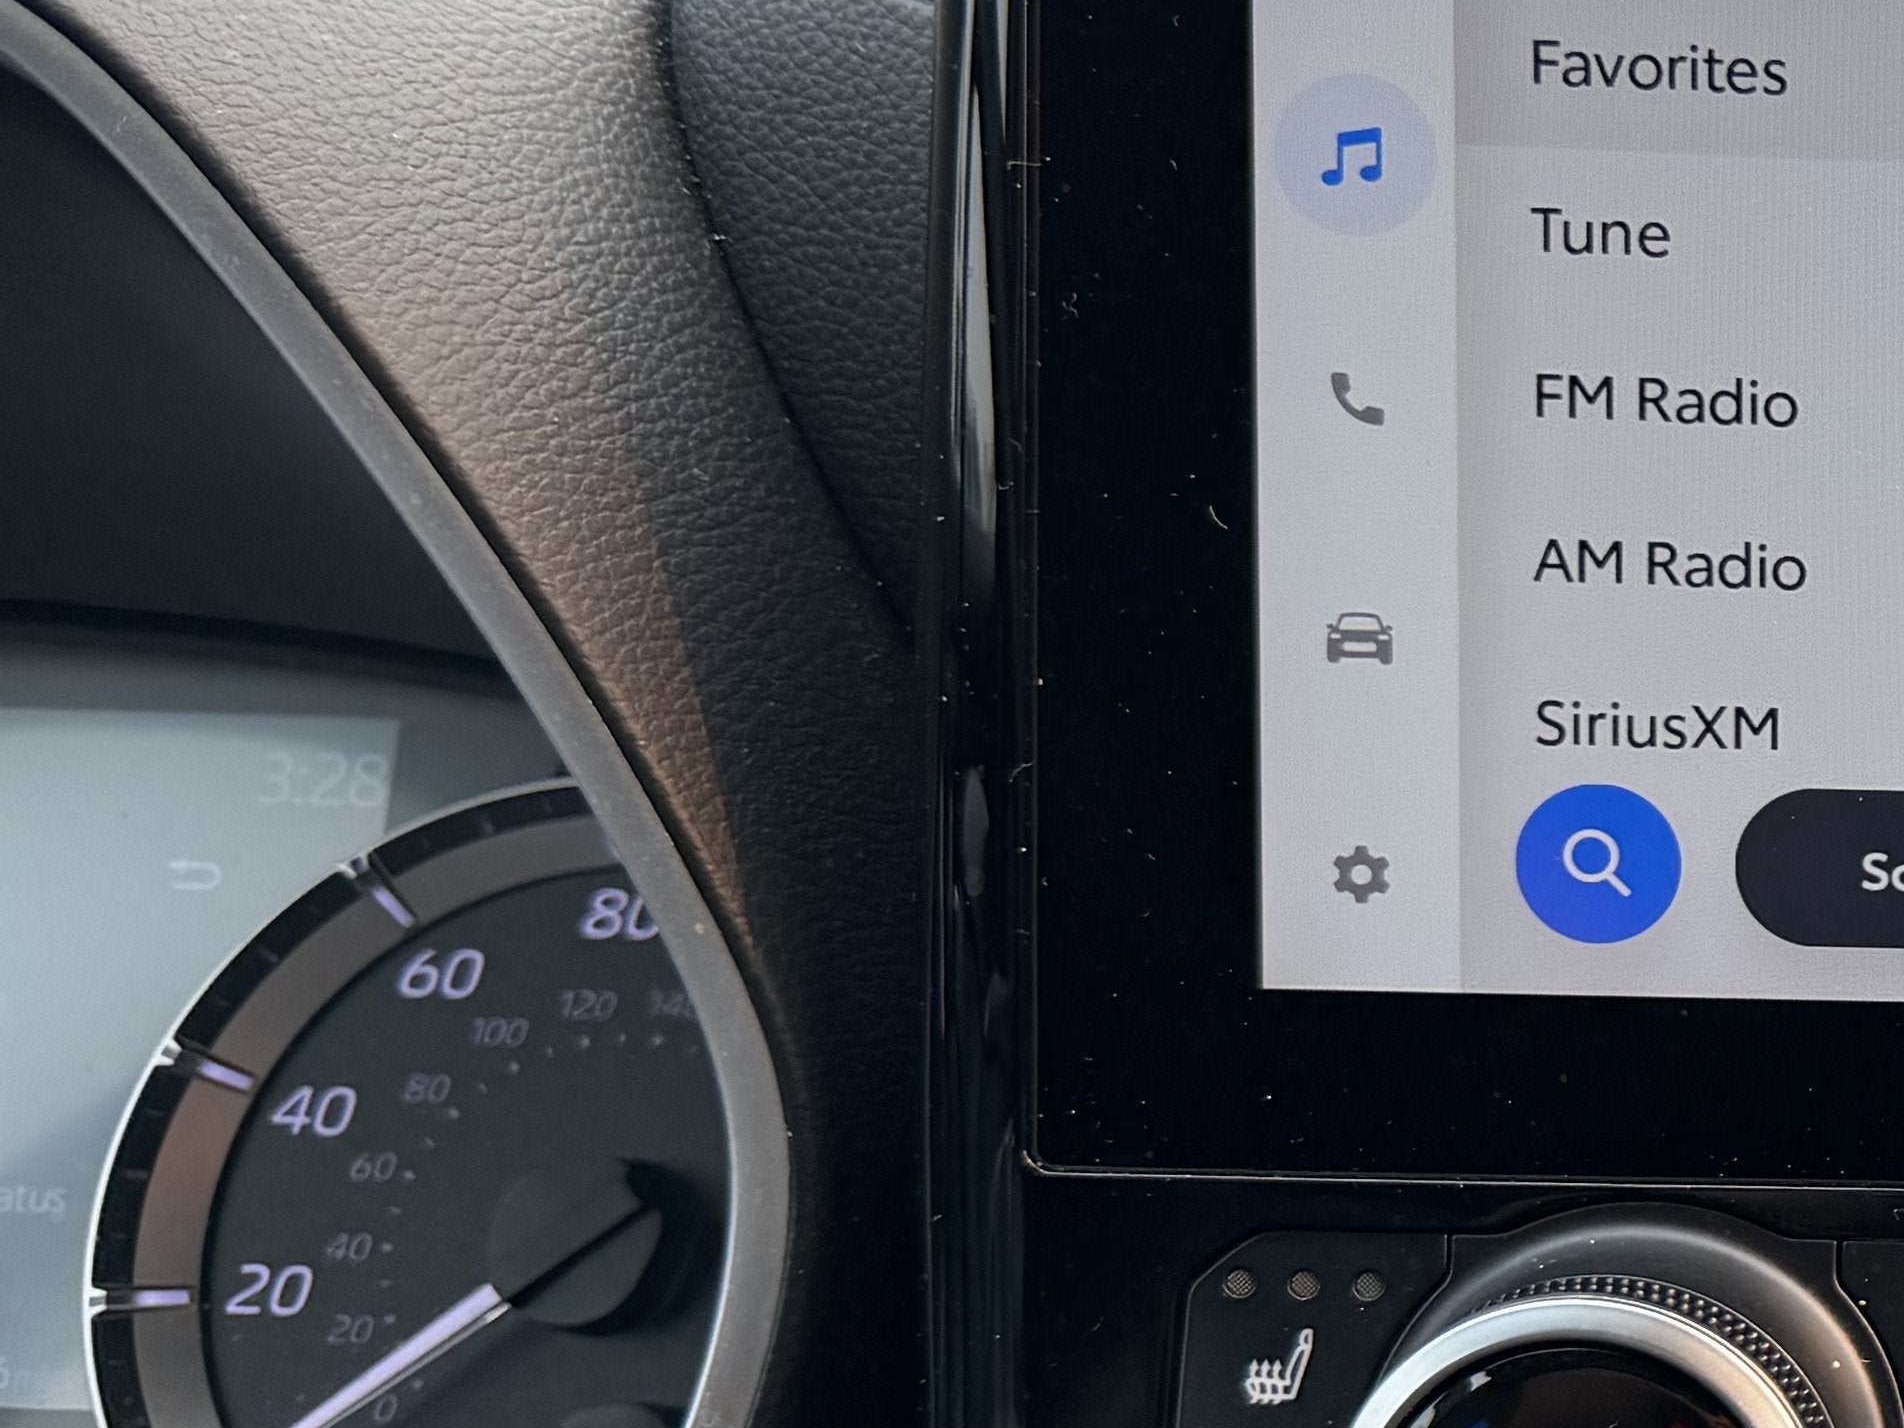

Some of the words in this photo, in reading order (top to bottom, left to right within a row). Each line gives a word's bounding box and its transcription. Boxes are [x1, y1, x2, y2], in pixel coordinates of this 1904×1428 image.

[1531, 39, 1788, 97] Favorites
[1531, 206, 1672, 262] Tune
[1534, 374, 1616, 421] FM
[1636, 376, 1799, 429] Radio
[1533, 539, 1624, 587] AM
[1645, 540, 1807, 593] Radio
[1533, 699, 1782, 752] SiriusXM
[400, 948, 485, 999] 60
[472, 1016, 529, 1048] 100
[271, 1085, 357, 1137] 40
[403, 1073, 452, 1104] 80
[349, 1151, 397, 1182] 60
[327, 1232, 373, 1261] 40
[225, 1264, 312, 1317] 20
[327, 1313, 374, 1345] 20
